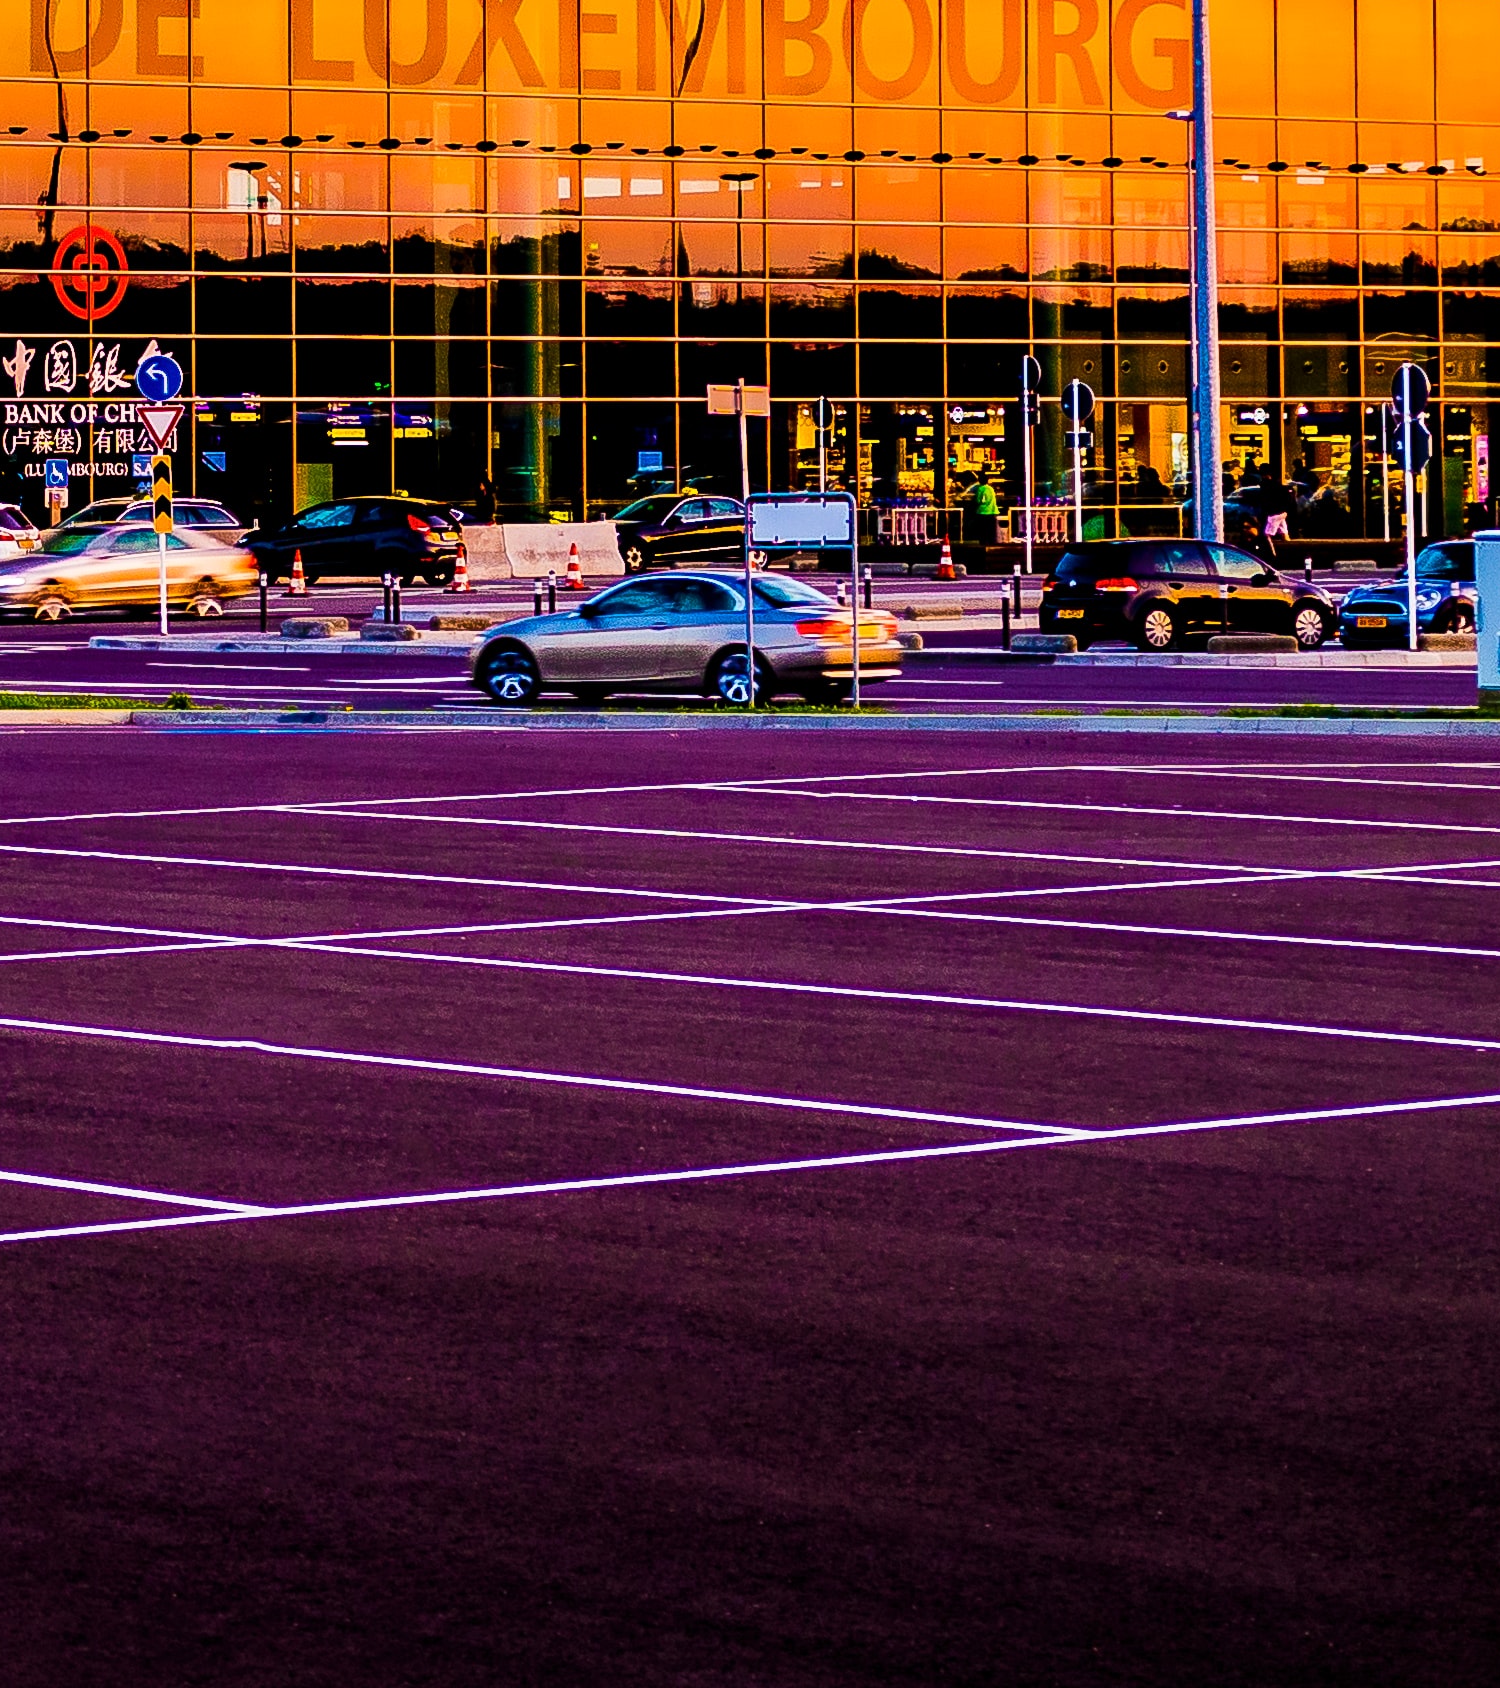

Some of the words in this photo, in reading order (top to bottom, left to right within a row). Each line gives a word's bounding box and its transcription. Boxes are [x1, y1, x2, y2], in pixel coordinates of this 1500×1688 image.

[4, 404, 66, 424] BANK
[70, 404, 99, 423] OF
[24, 462, 129, 477] (LUMBOURG)
